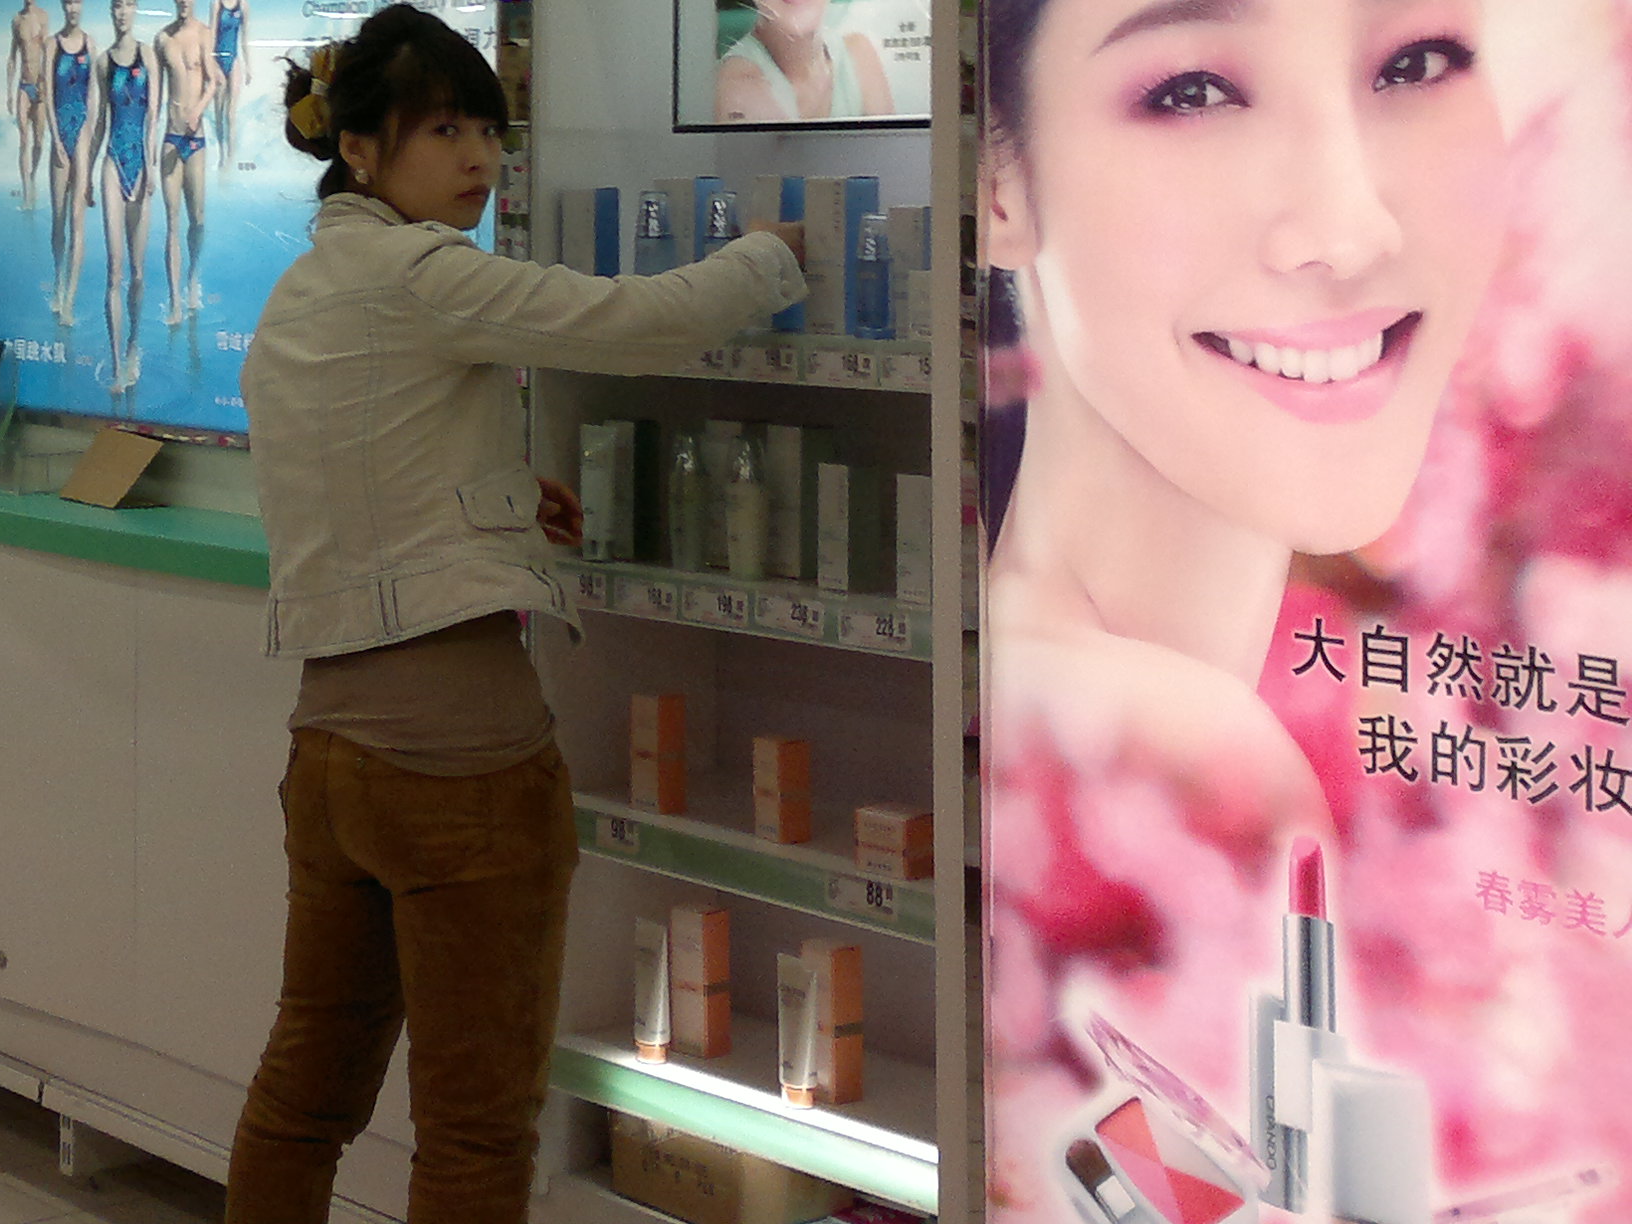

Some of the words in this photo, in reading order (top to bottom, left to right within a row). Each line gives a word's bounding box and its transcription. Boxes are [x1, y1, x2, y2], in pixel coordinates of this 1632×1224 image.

[1292, 618, 1631, 726] 大自然就是
[1357, 713, 1632, 817] 我的彩妆
